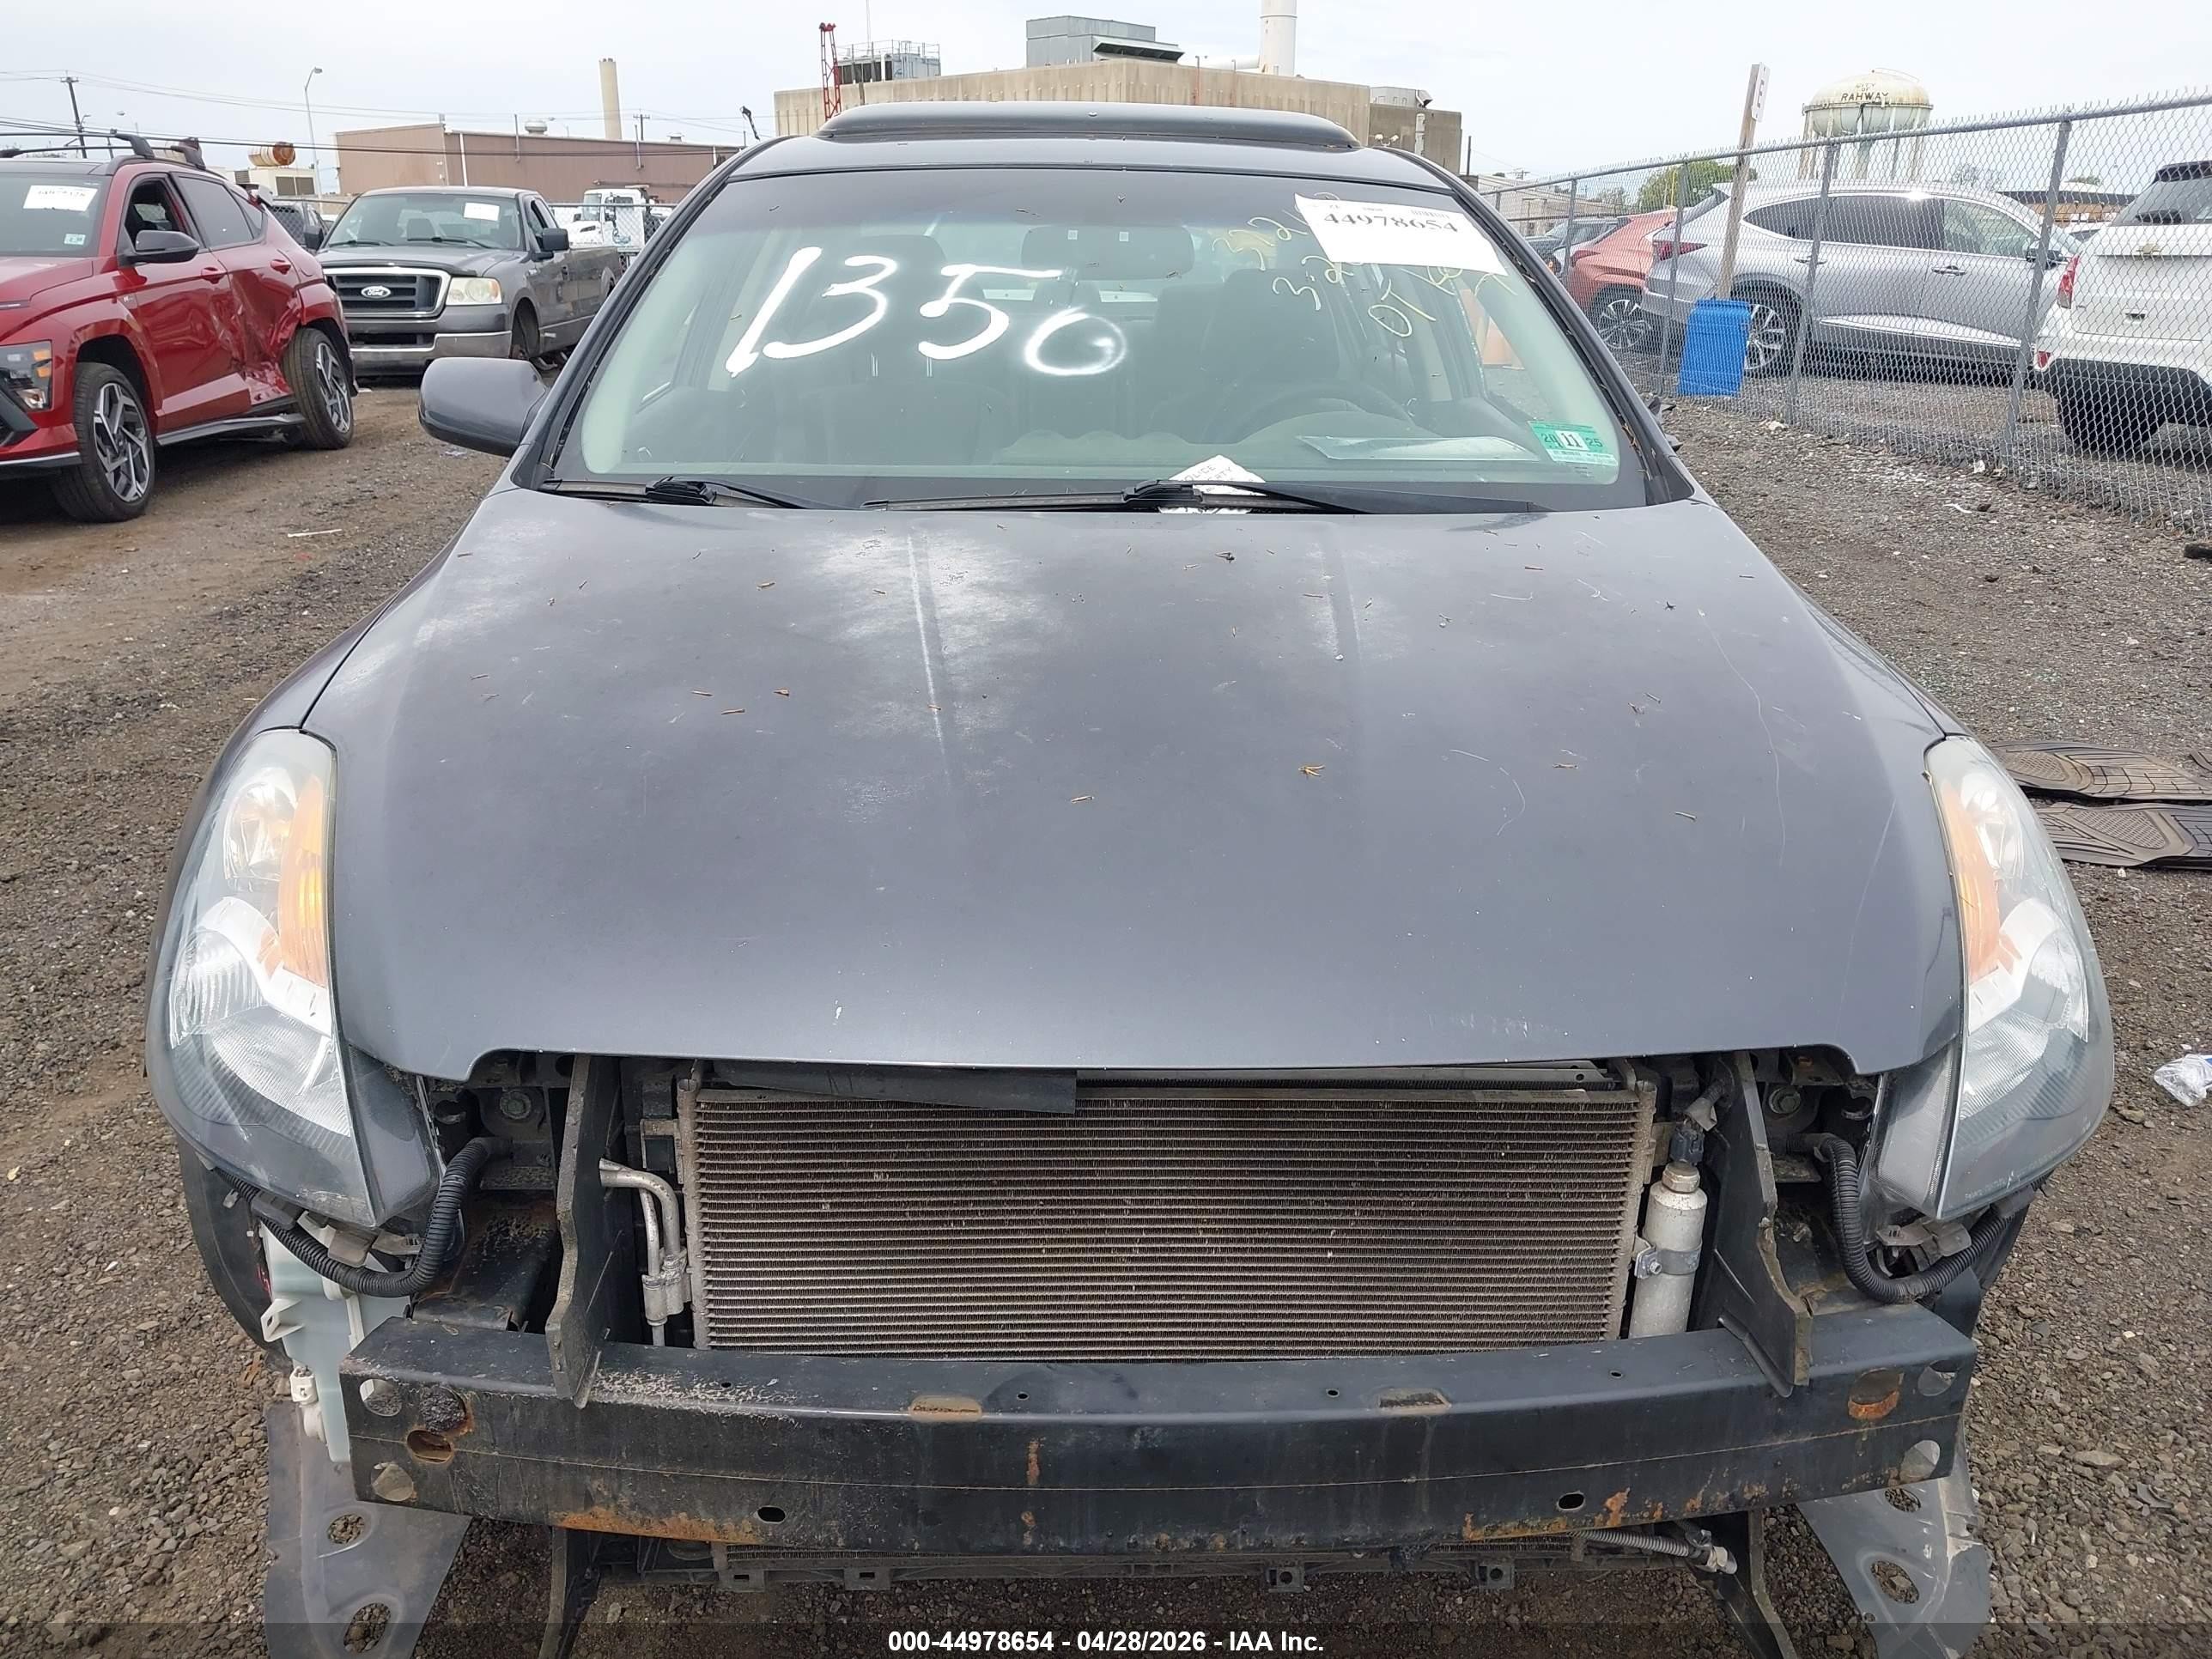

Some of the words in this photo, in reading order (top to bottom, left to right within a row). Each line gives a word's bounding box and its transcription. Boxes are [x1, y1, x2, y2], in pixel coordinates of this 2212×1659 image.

[1840, 92, 1889, 101] RAHWAY
[1323, 212, 1459, 233] 44978654
[1560, 432, 1583, 448] 11
[1585, 437, 1603, 447] 25
